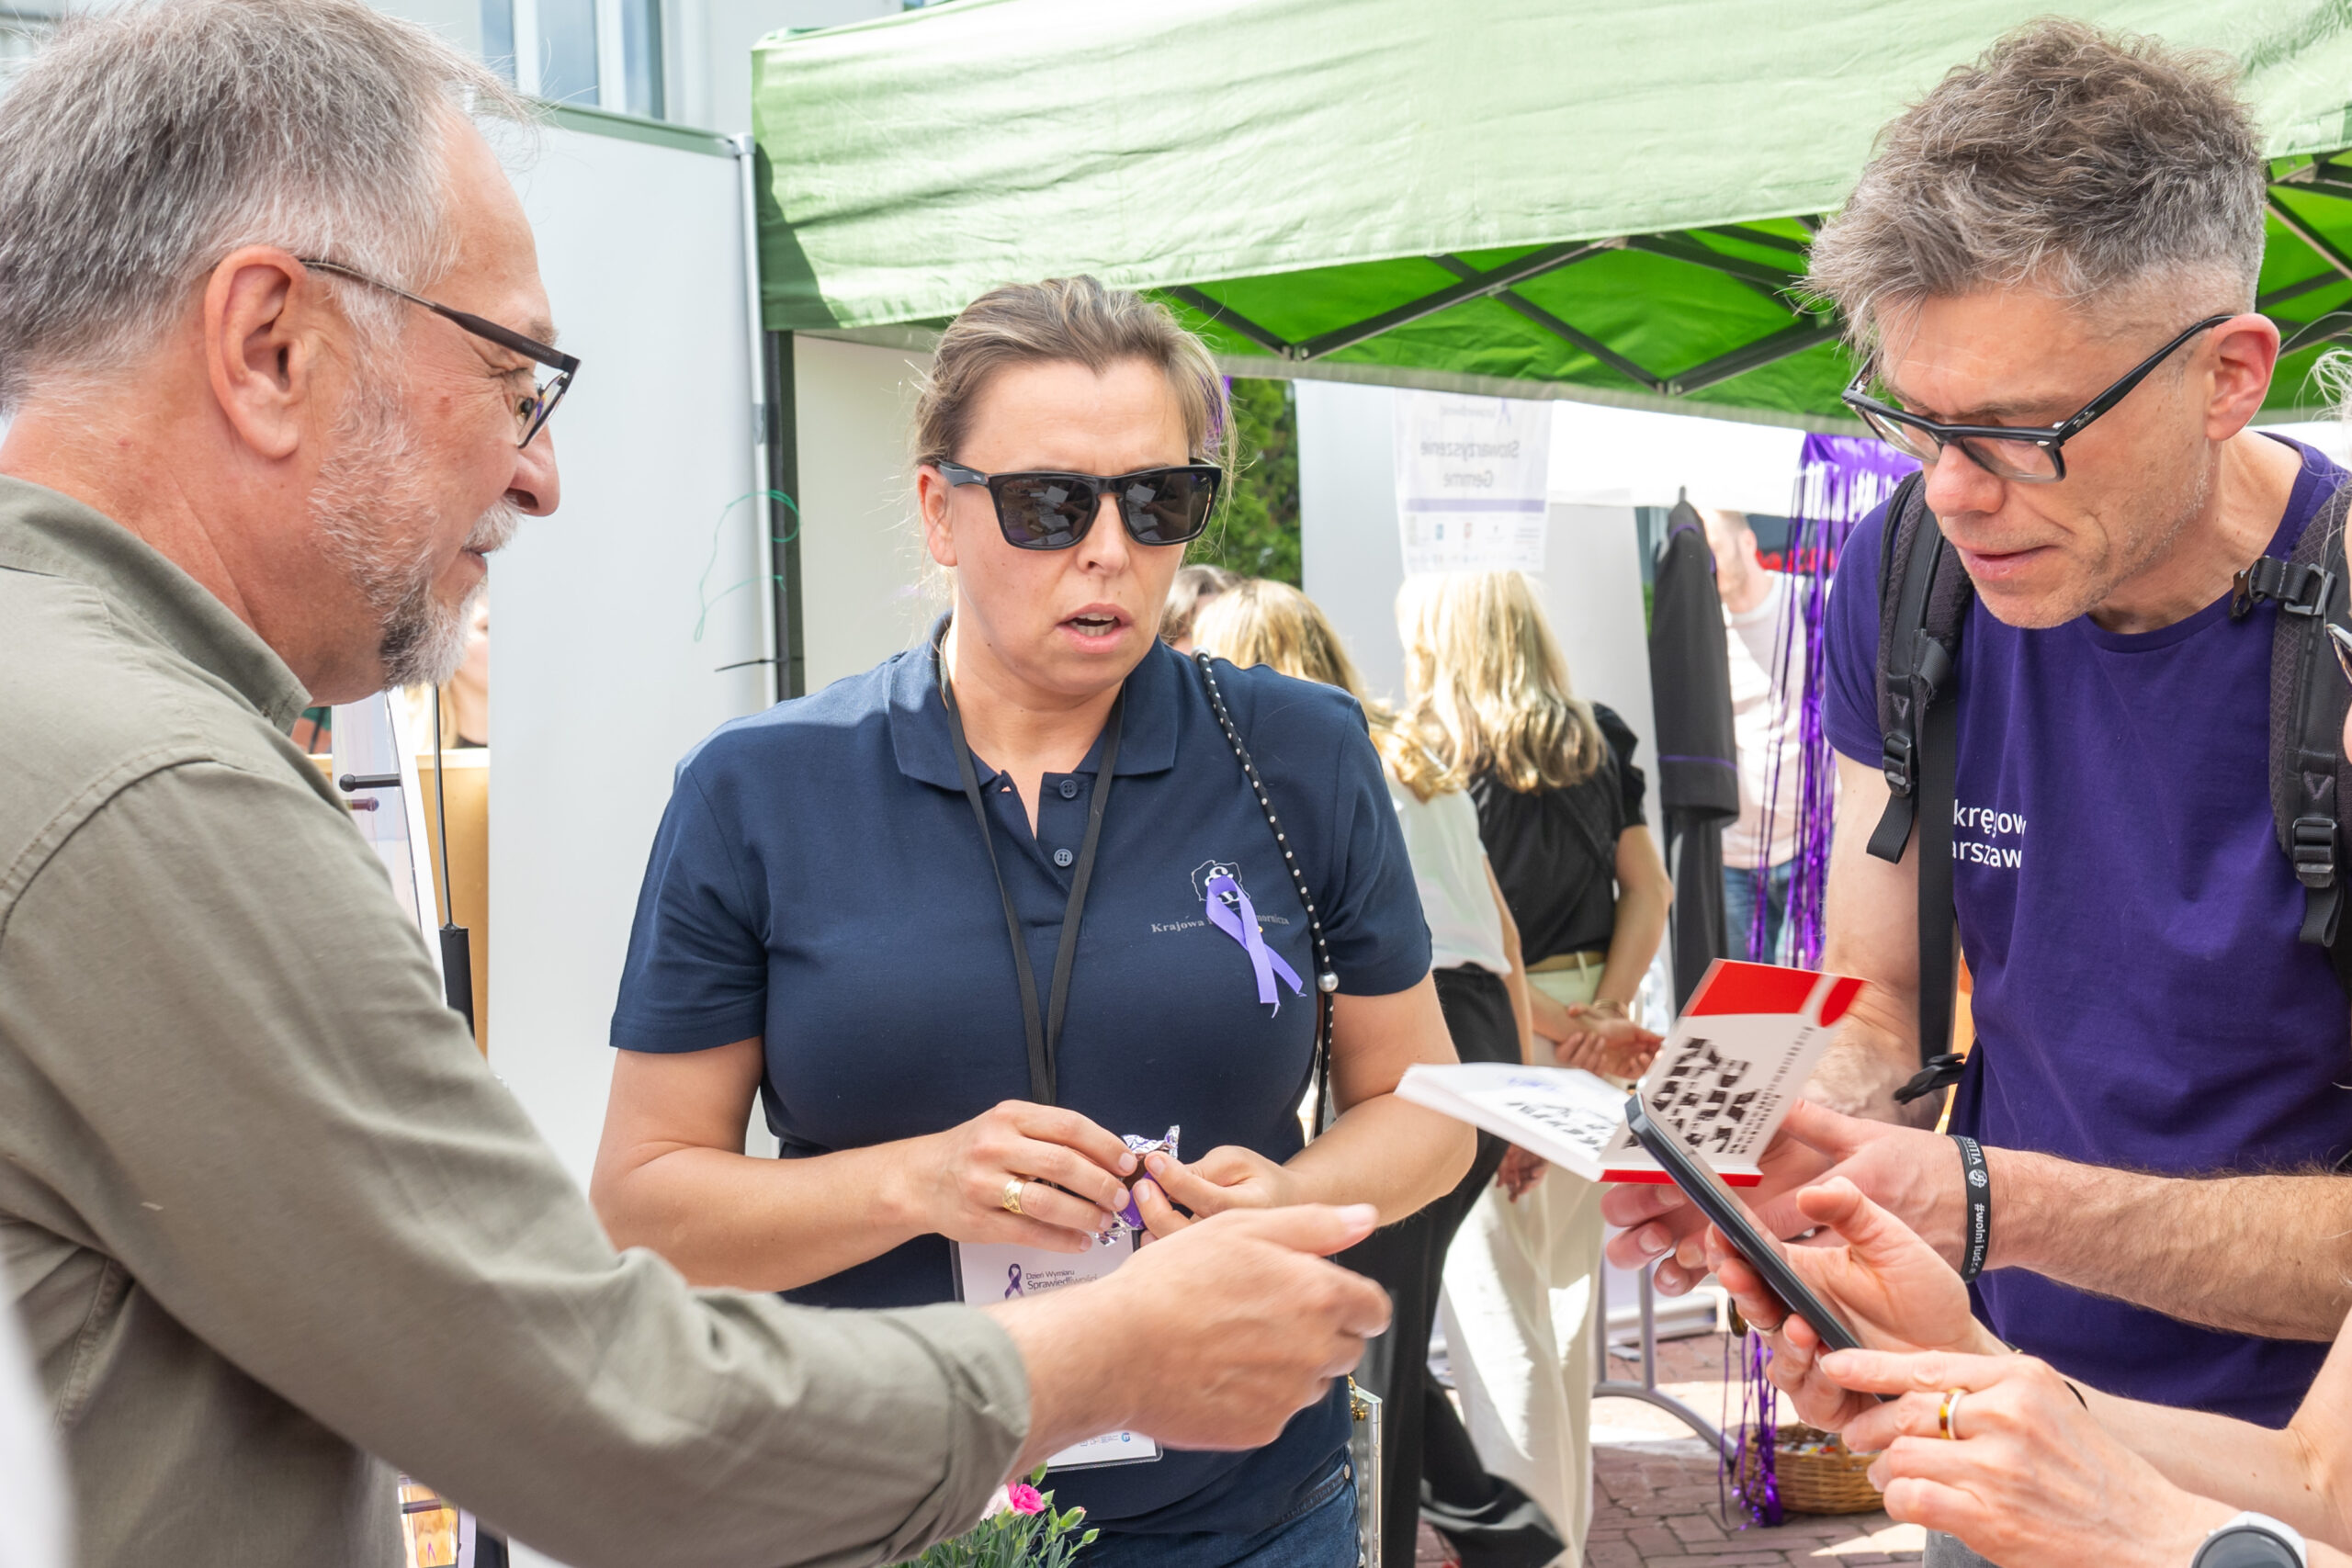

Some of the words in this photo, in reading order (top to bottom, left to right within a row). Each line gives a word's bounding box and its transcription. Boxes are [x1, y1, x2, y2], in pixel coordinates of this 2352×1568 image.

[1151, 919, 1204, 933] Krajowa
[1973, 1203, 1985, 1244] #wolni
[1025, 1271, 1045, 1280] Dzień
[1046, 1269, 1075, 1279] Wymiaru
